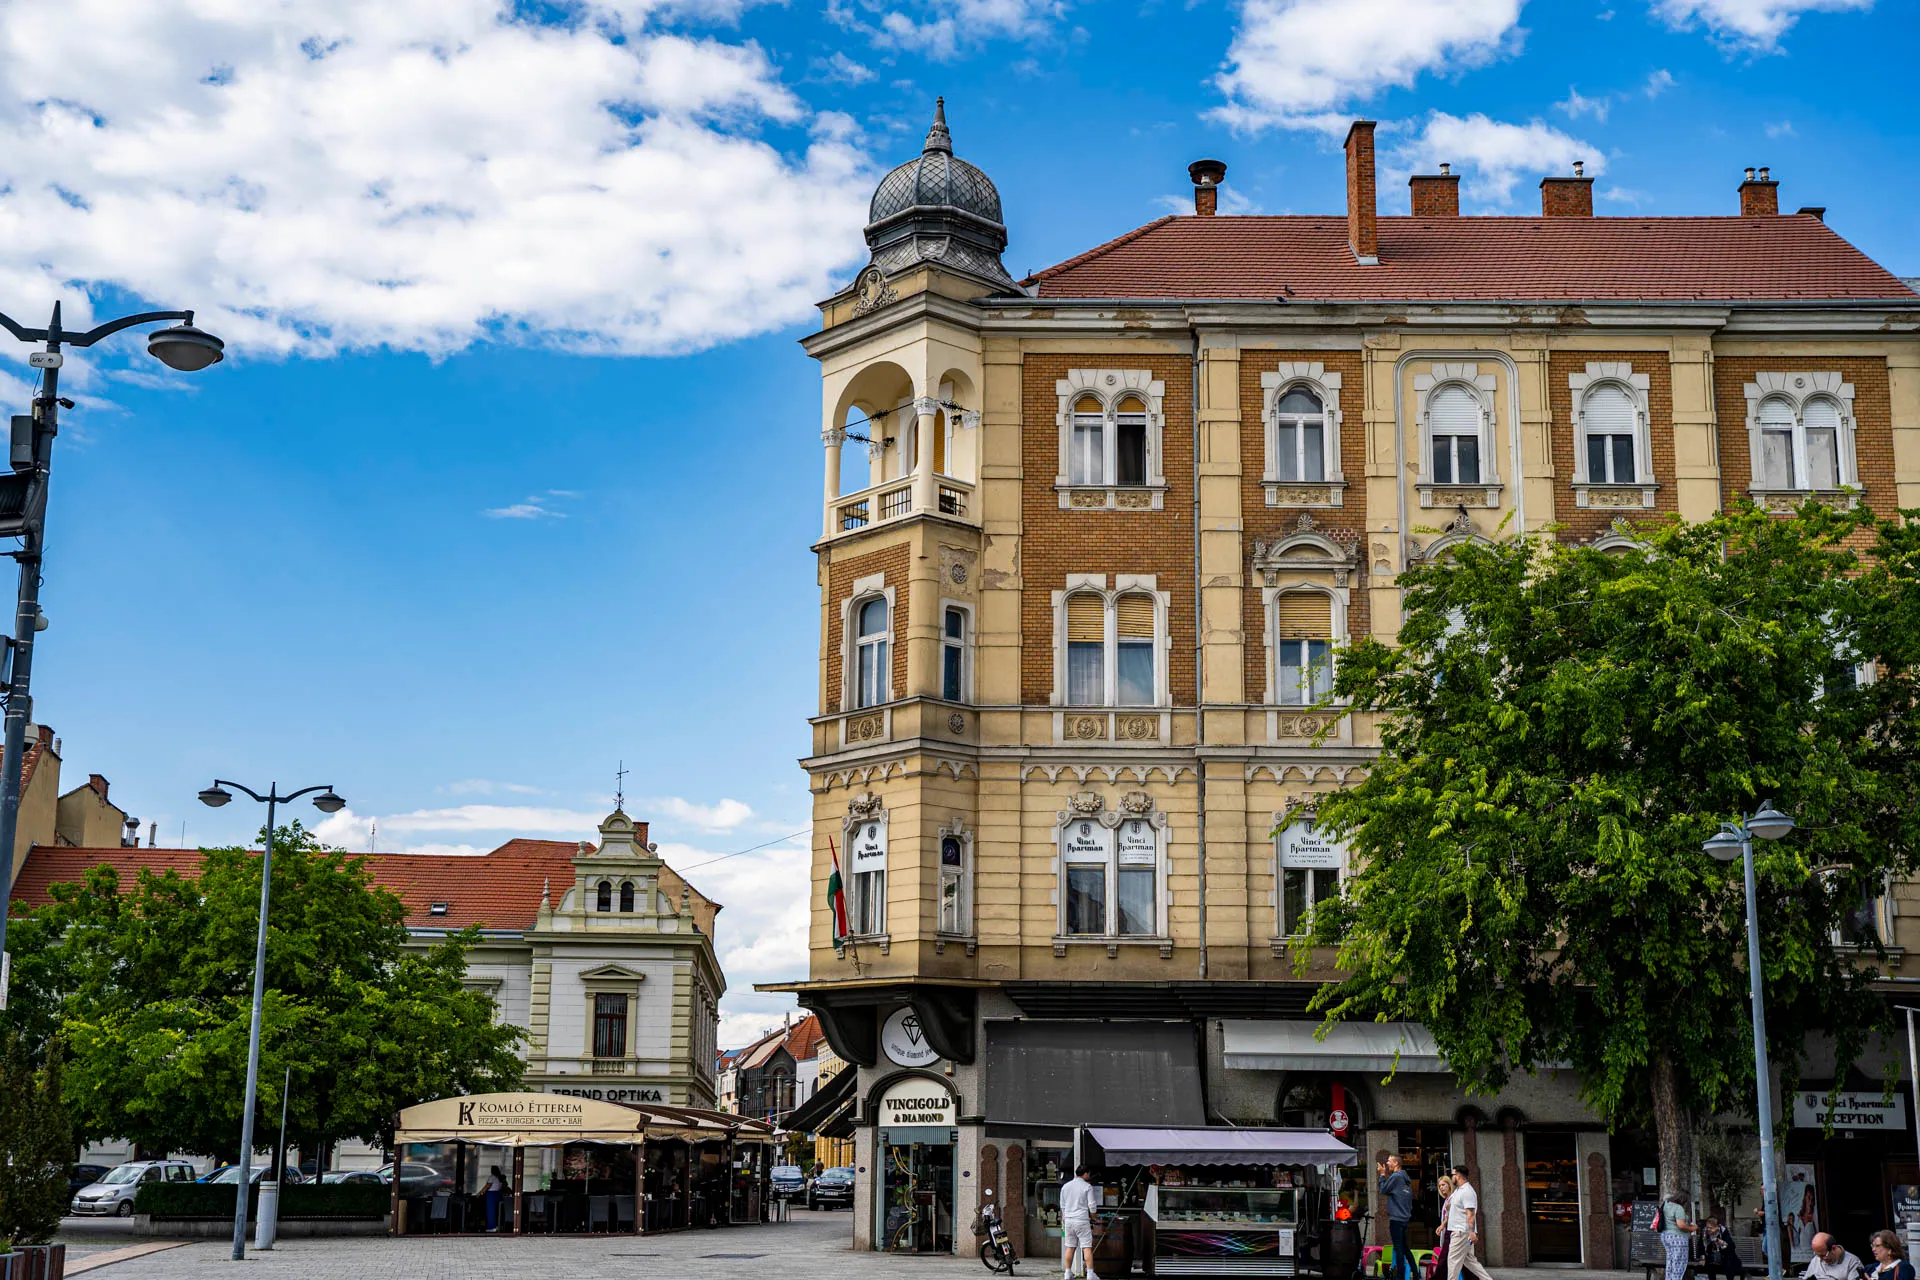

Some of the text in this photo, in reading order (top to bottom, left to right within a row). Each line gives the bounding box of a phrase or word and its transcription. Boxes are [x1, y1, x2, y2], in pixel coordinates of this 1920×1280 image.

[1076, 836, 1095, 845] Vinci
[1127, 836, 1146, 844] Vinci
[1301, 836, 1321, 845] Vinci
[1067, 843, 1103, 853] Apartman
[1290, 843, 1331, 854] Apartman
[607, 1090, 662, 1102] OPTIKA
[885, 1097, 950, 1110] VINCIGOLD
[478, 1117, 498, 1125] PIZZA
[506, 1117, 535, 1125] BURGER
[568, 1117, 582, 1125] BAR
[902, 1113, 944, 1123] DIAMOND
[1816, 1113, 1884, 1125] RCEPTION
